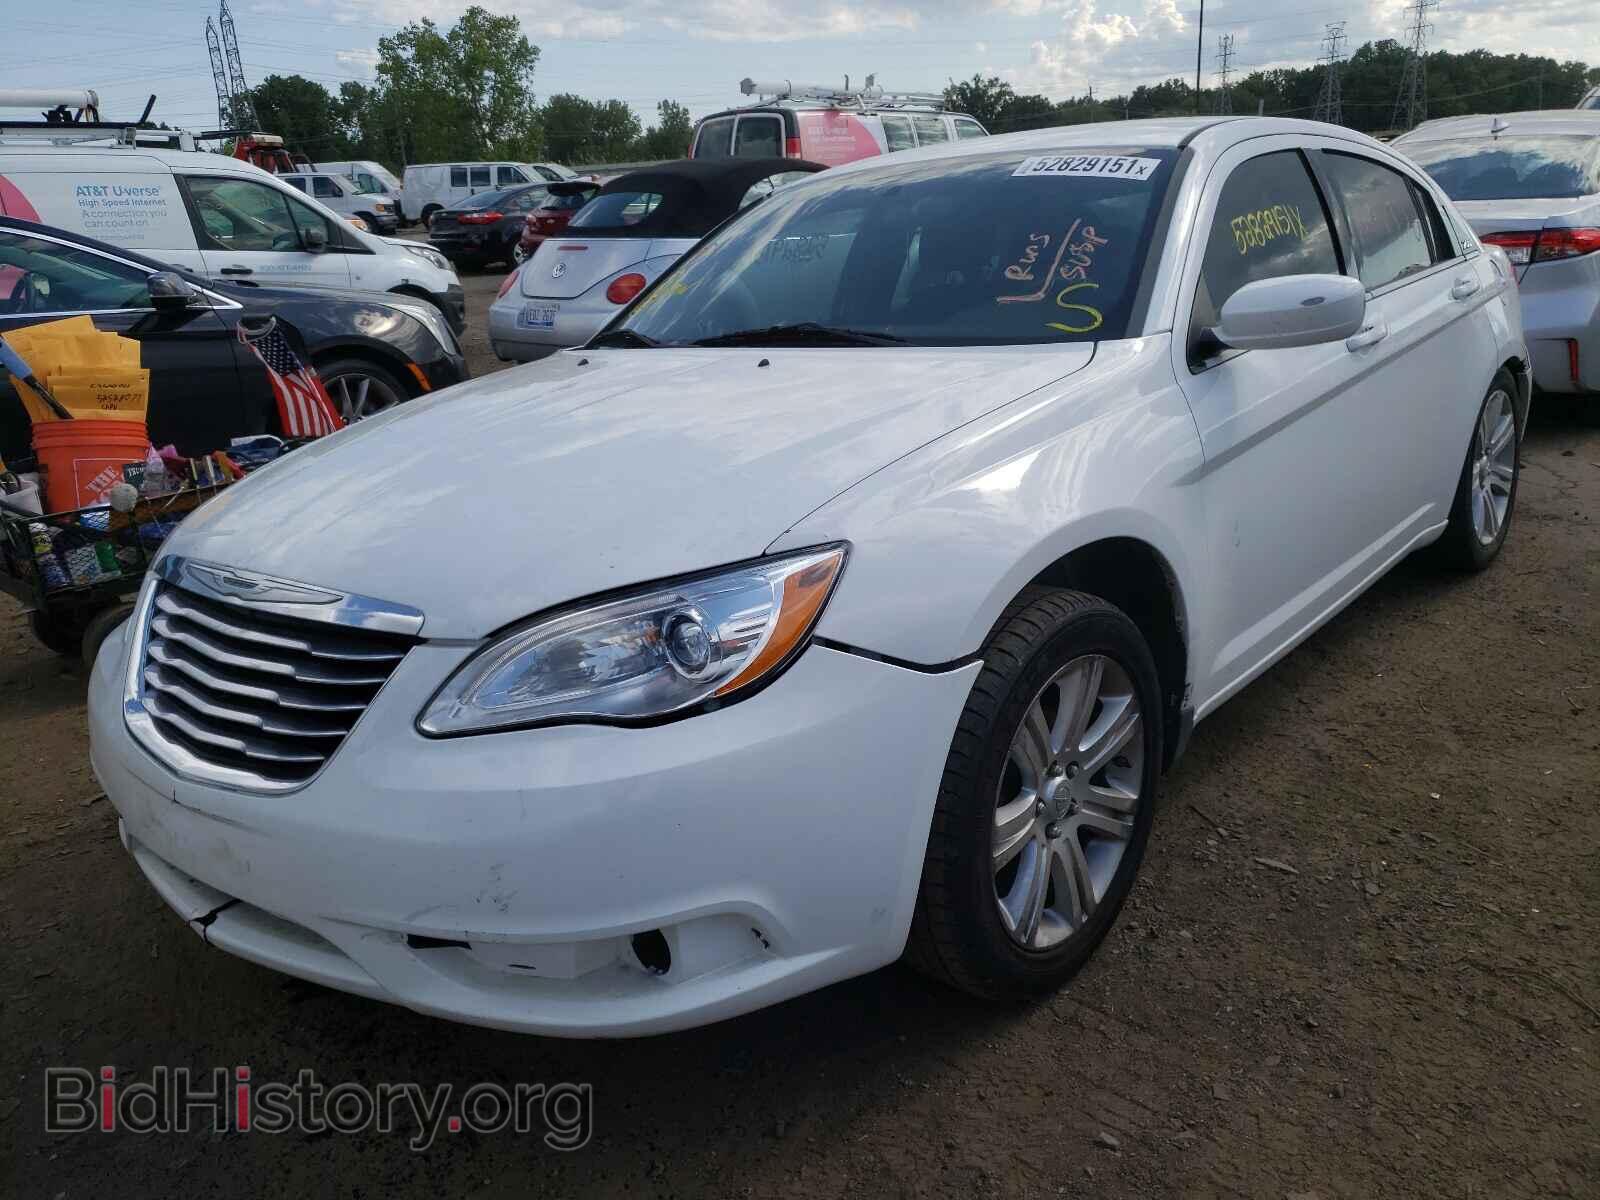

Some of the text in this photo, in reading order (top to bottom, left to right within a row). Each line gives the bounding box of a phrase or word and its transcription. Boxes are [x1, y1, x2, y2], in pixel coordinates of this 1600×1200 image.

[76, 185, 108, 197] AT&T
[79, 199, 167, 209] High Speed Internet
[90, 208, 148, 218] connection
[149, 209, 167, 218] you
[1045, 282, 1103, 333] S
[85, 465, 118, 493] THE
